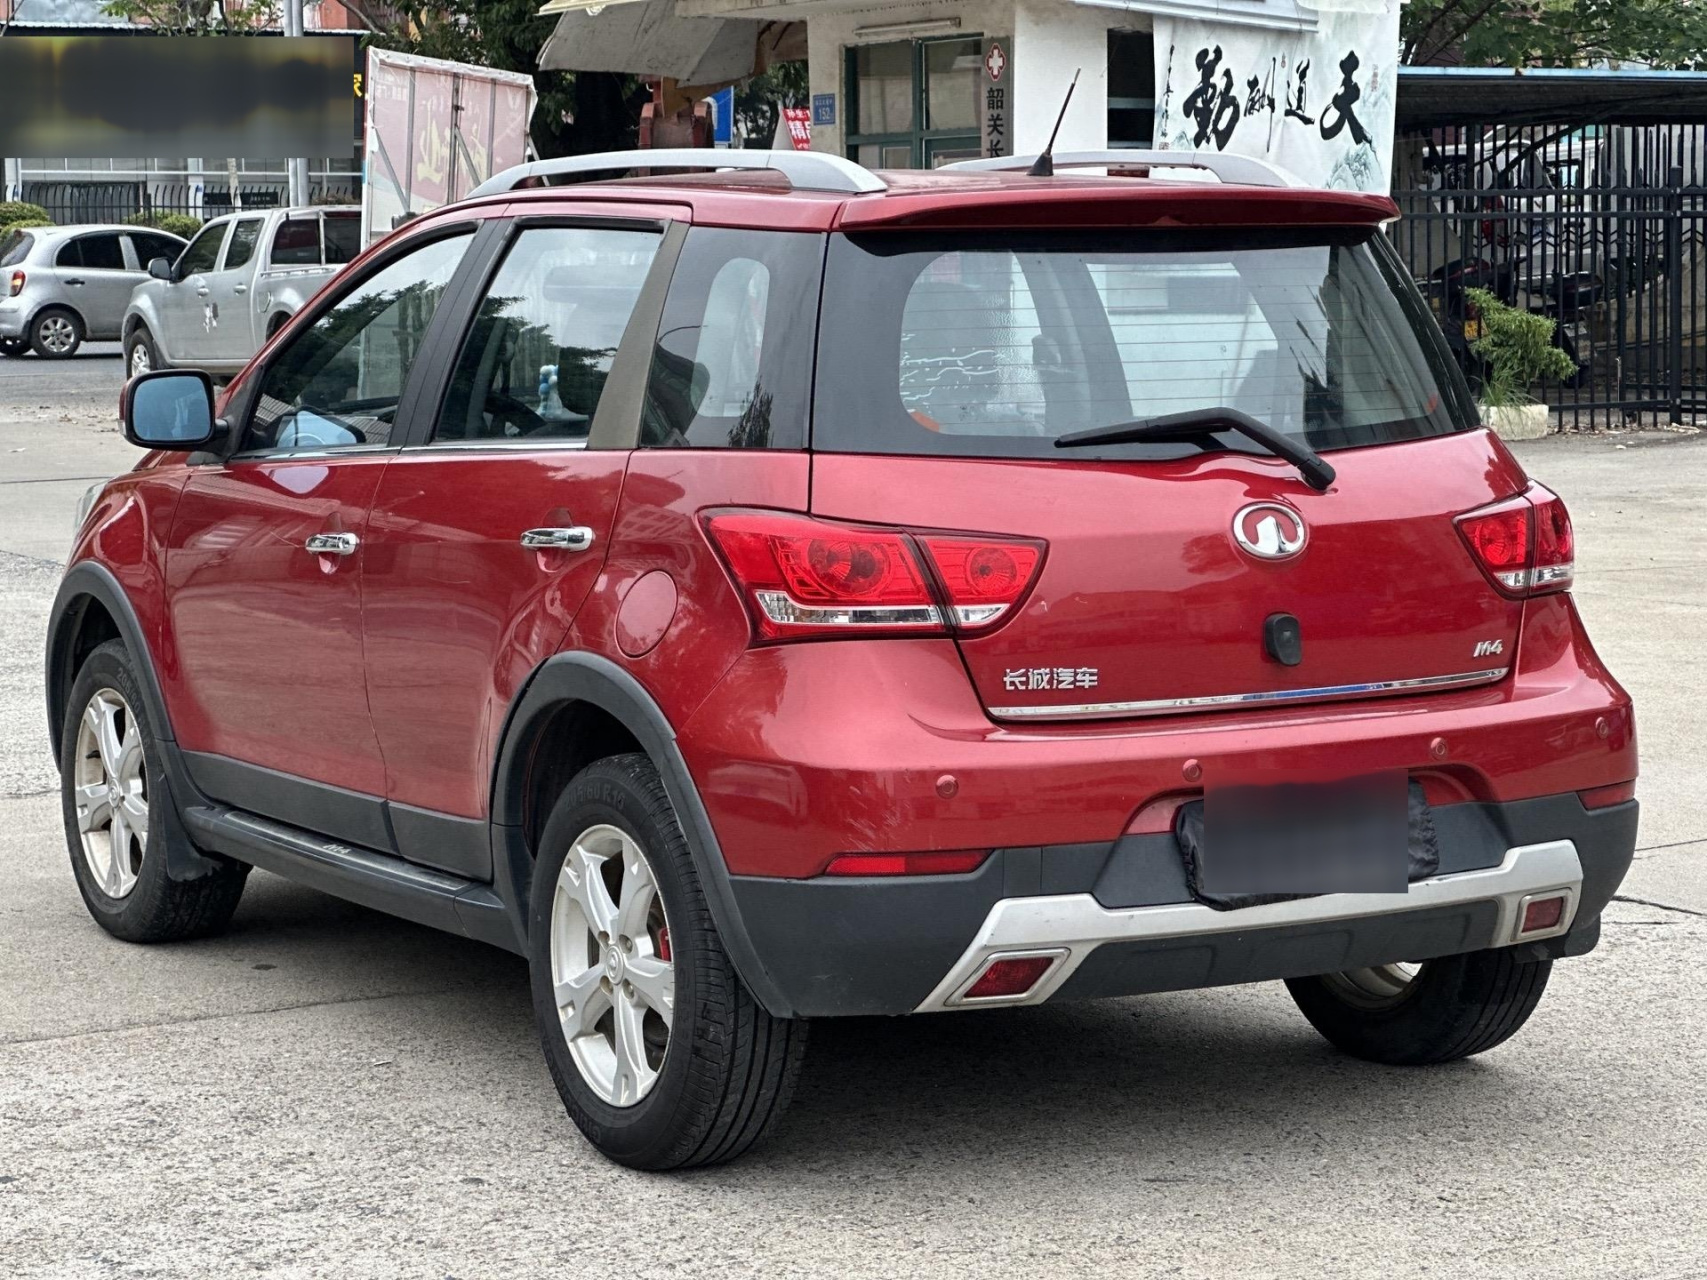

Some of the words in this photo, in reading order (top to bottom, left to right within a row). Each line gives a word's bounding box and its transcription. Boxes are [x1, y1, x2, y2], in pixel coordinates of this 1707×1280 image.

[986, 87, 1004, 158] 韶关长
[1473, 639, 1503, 657] M4
[1003, 667, 1098, 690] 长城汽车
